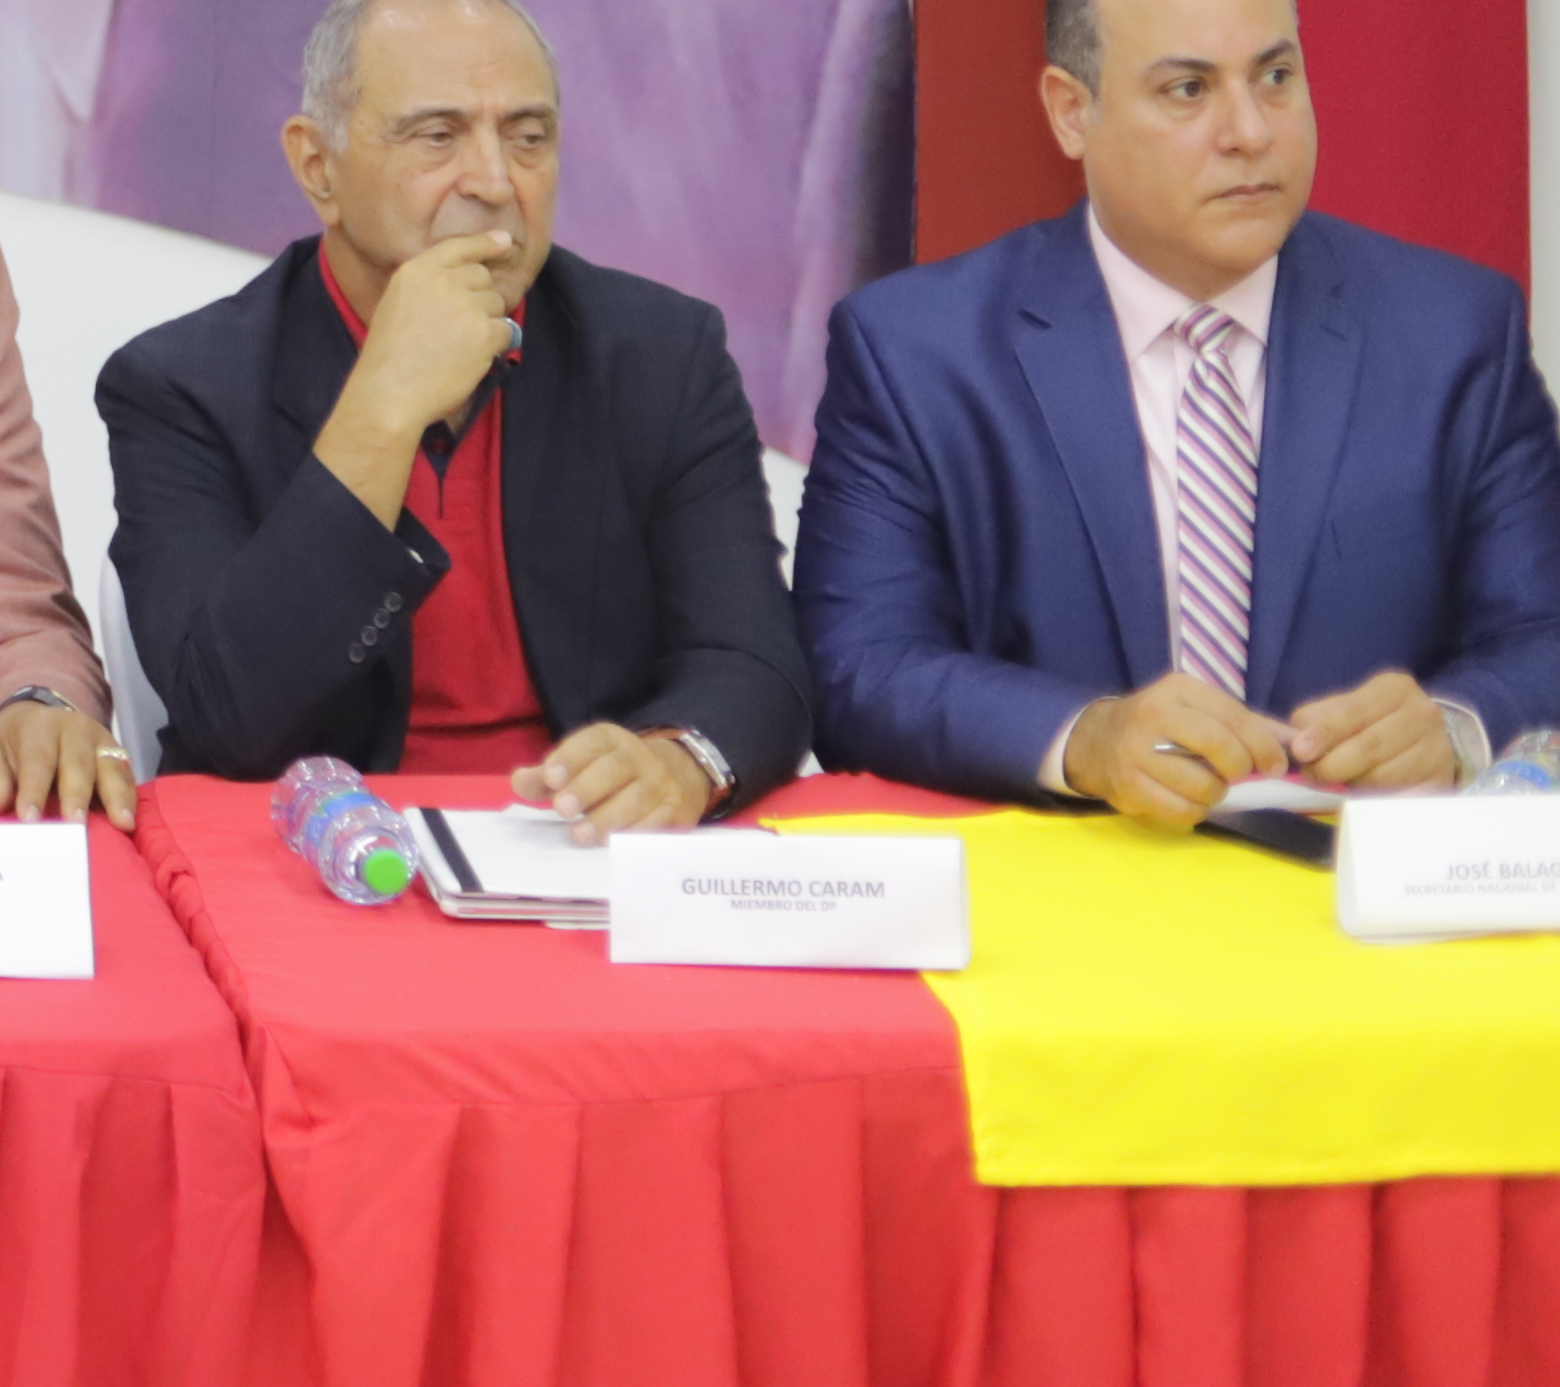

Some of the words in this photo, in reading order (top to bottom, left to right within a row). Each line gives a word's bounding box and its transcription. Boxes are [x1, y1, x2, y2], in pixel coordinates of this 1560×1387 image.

[1447, 859, 1494, 880] JOSÉ
[681, 877, 802, 897] GUILLERMO
[809, 879, 885, 899] CARAM
[1404, 882, 1474, 895] SECRETARIO
[1478, 881, 1536, 895] NACIONAL
[731, 900, 792, 911] MIEMBRO
[796, 900, 818, 912] DEL
